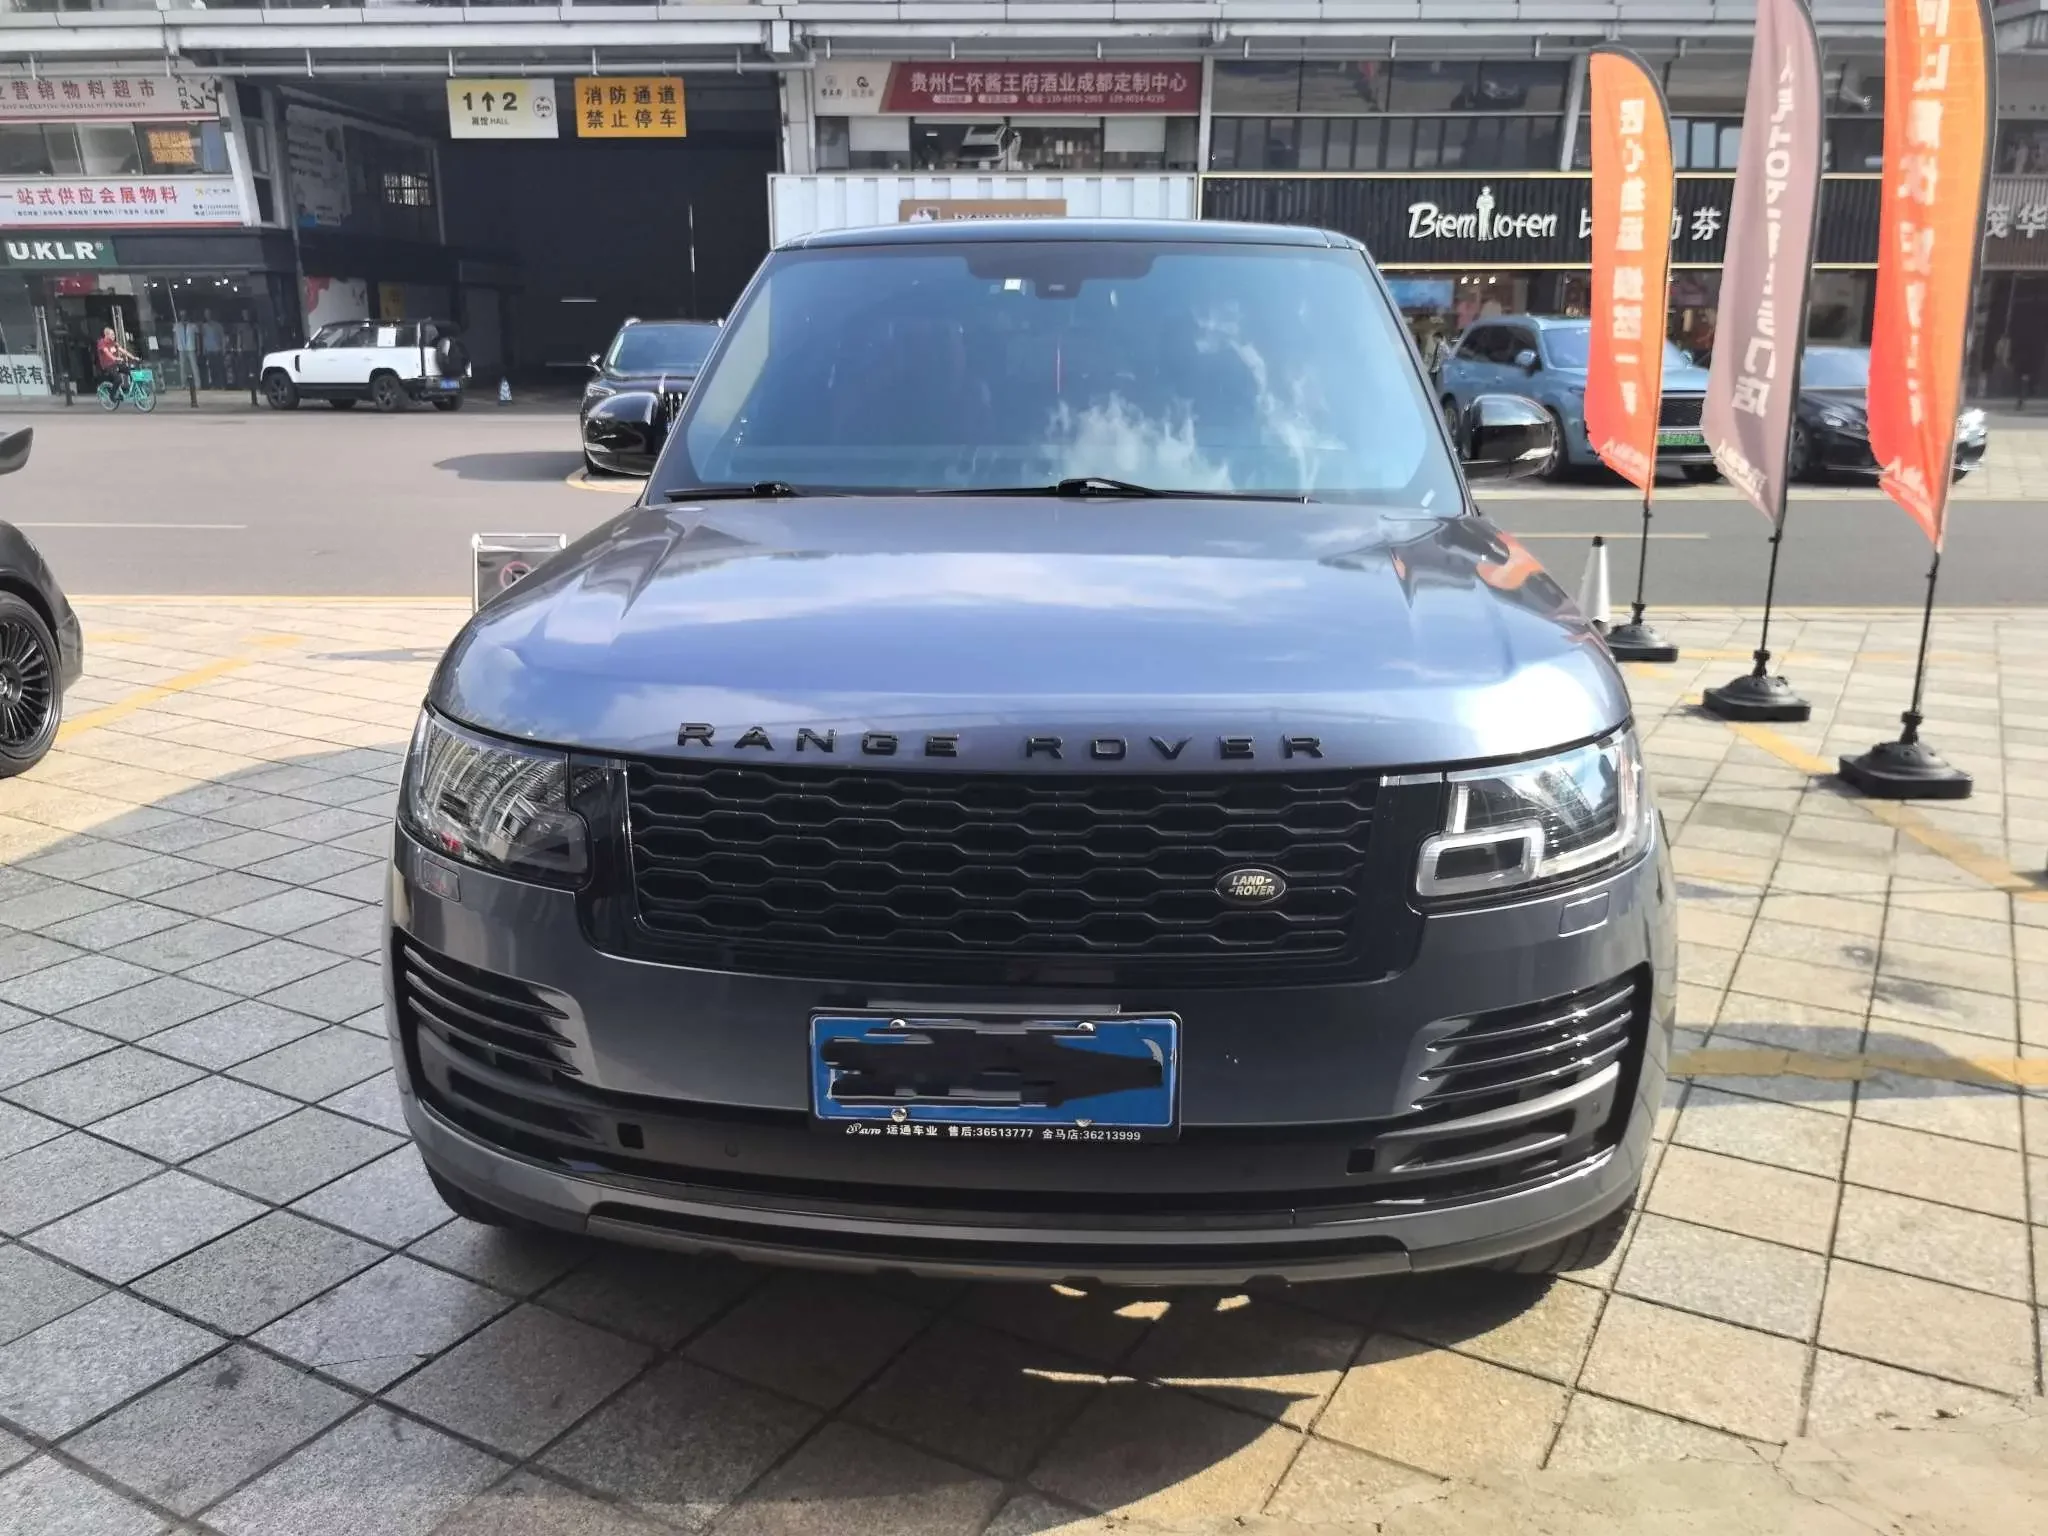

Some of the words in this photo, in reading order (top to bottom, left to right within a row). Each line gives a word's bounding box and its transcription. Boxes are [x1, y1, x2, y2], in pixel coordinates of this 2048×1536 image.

[0, 79, 155, 100] 营销物料超市
[585, 86, 676, 105] 消防通道
[463, 92, 472, 111] 1
[503, 92, 517, 111] 2
[586, 109, 677, 129] 禁止停车
[0, 184, 178, 206] 一站式供应会展物料
[677, 721, 960, 758] RANGE
[1025, 734, 1325, 760] ROVER
[886, 1124, 938, 1136] 运通车业
[948, 1125, 1034, 1138] 售后:36513777
